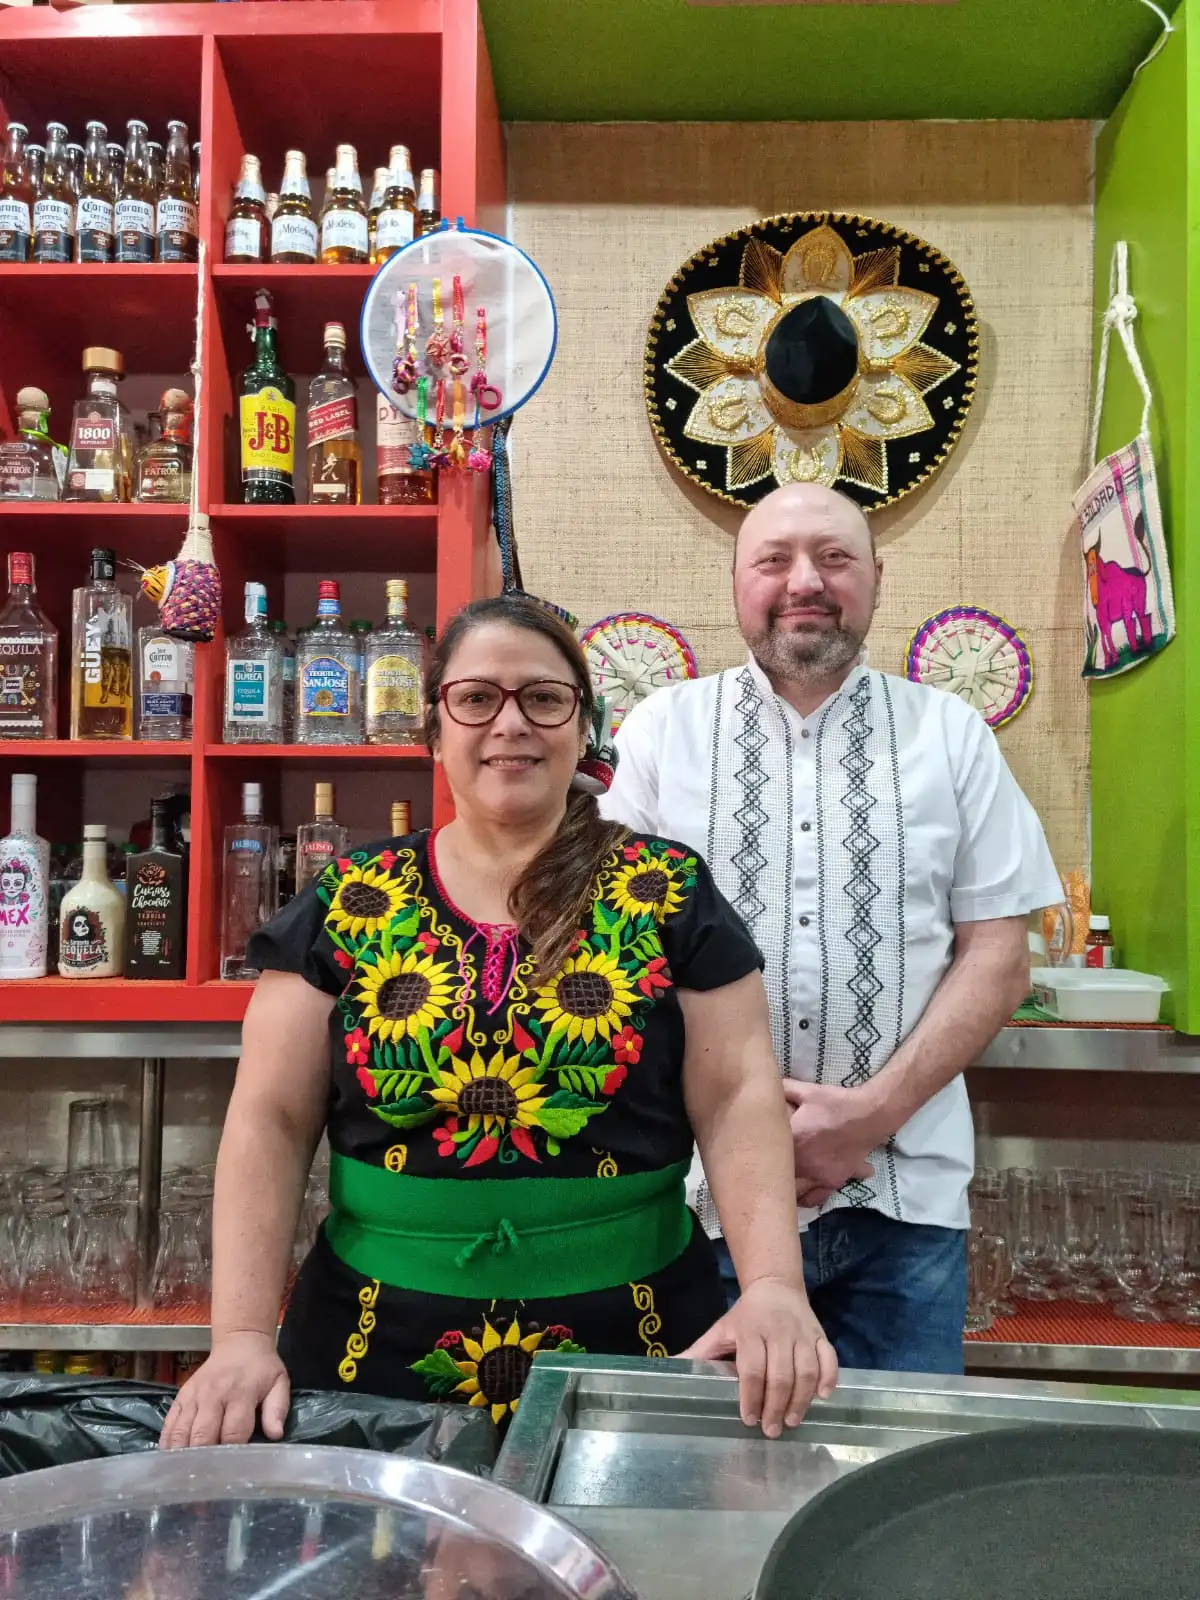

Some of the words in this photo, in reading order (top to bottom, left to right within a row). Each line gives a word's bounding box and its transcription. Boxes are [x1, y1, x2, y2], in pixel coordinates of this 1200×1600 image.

[34, 202, 70, 216] Corona
[115, 202, 151, 216] Corona
[160, 201, 195, 216] Corona
[379, 406, 398, 421] DY
[78, 427, 111, 440] 1800
[248, 412, 290, 454] J&B
[80, 622, 101, 684] GÜEY
[235, 672, 263, 681] OLMECA
